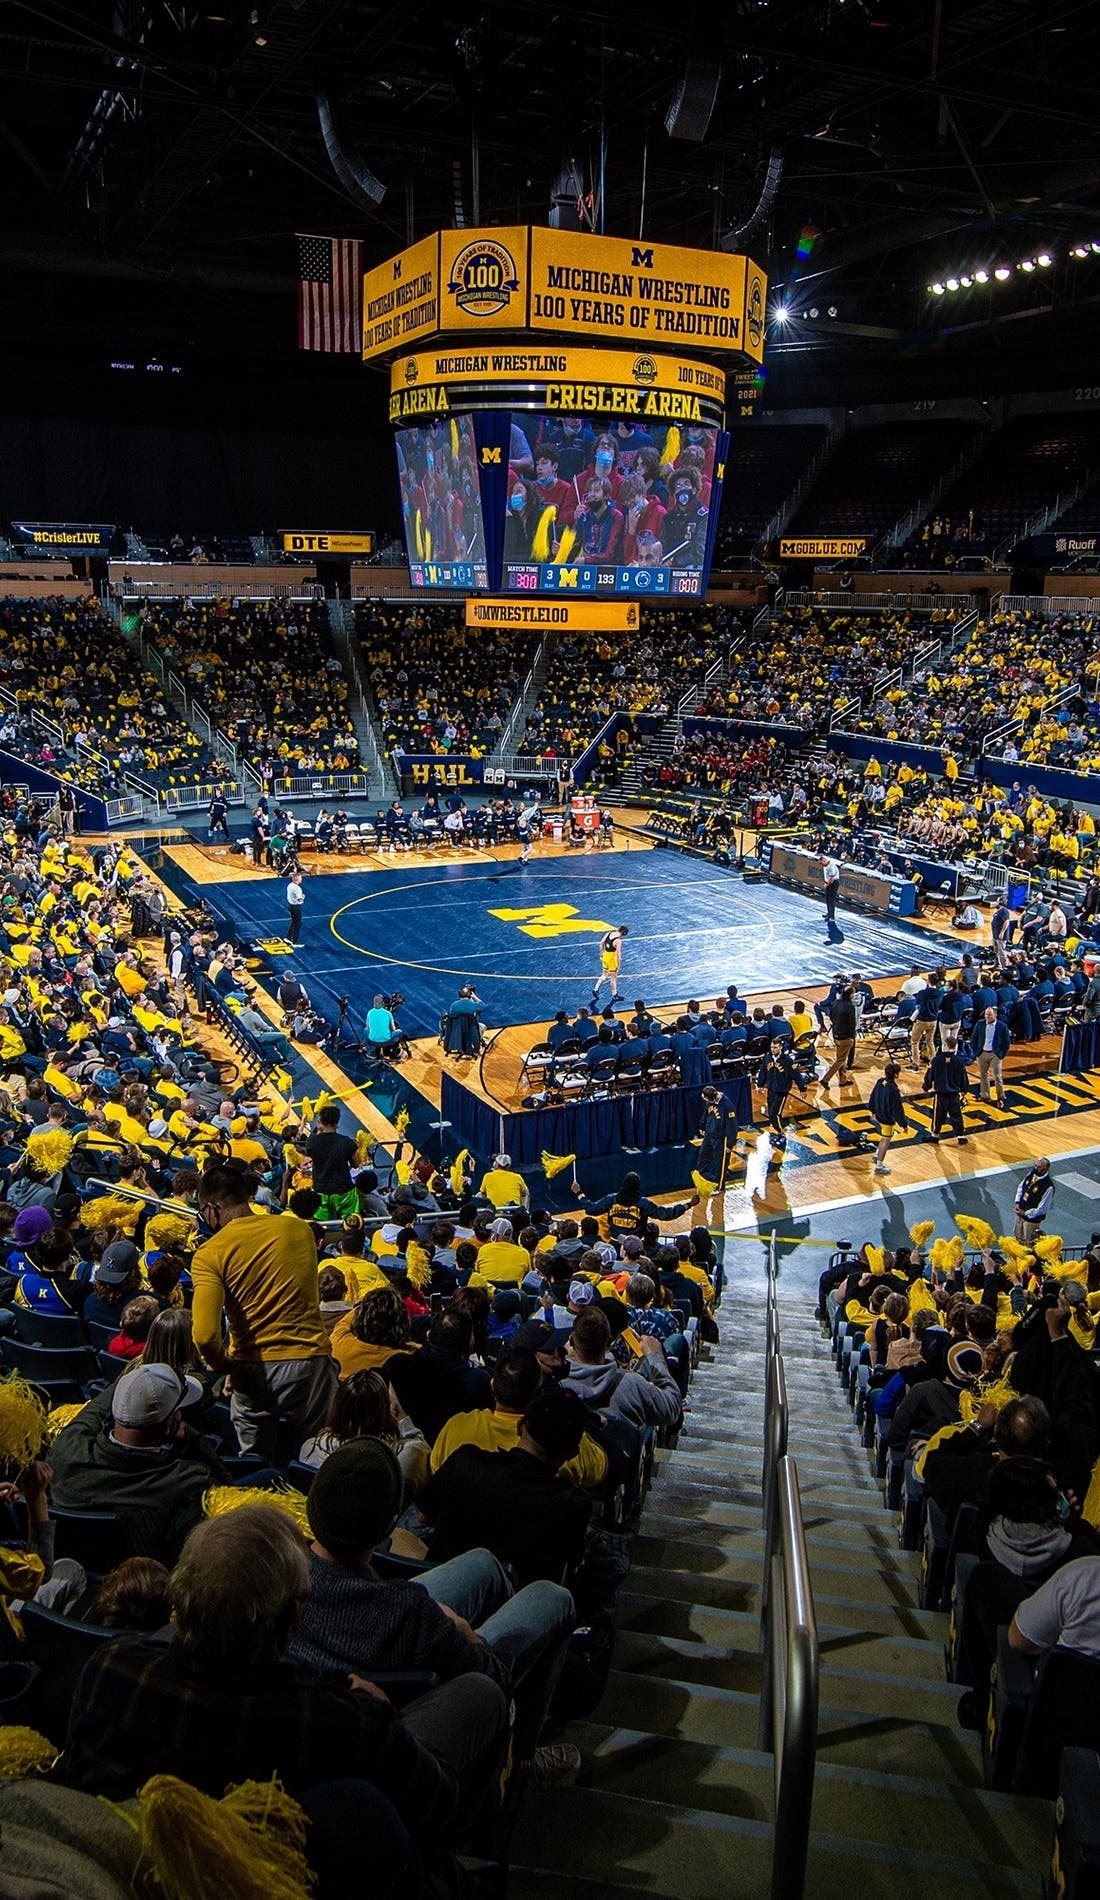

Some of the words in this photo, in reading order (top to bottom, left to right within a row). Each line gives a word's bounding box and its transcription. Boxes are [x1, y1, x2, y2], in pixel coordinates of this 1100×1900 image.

[488, 246, 511, 277] TRADITION
[631, 247, 654, 268] M
[393, 260, 402, 280] M
[467, 265, 499, 288] 100
[547, 265, 634, 298] MICHIGAN
[638, 276, 730, 309] WRESTLING
[367, 290, 395, 322] MICHIGAN
[396, 272, 432, 308] WRESTLING
[458, 291, 482, 303] MICHIGAN
[482, 291, 509, 301] WRESTLING
[363, 328, 374, 350] 100
[374, 319, 392, 346] YEARS
[393, 315, 400, 336] OF
[402, 298, 437, 333] TRADITION
[534, 294, 565, 319] 100
[570, 298, 625, 326] YEARS
[629, 305, 650, 329] OF
[654, 308, 740, 339] TRADITION
[435, 355, 489, 374] MICHIGAN
[491, 355, 567, 371] WRESTLING
[678, 366, 693, 383] 100
[695, 369, 714, 388] YEARS
[403, 386, 449, 415] ARENA
[545, 383, 640, 414] CRISLER
[644, 391, 702, 420] ARENA
[738, 390, 757, 399] 2021
[741, 405, 753, 416] M
[914, 400, 936, 411] 219
[482, 447, 501, 463] M
[717, 462, 725, 478] M
[33, 531, 101, 544] #CrislerLIVE
[292, 536, 329, 550] DTE
[1068, 539, 1097, 550] Ruoff
[782, 542, 864, 554] MGOBLUE.COM
[547, 570, 554, 580] 3
[559, 568, 578, 588] M
[584, 571, 591, 581] 0
[597, 574, 615, 585] 133
[622, 572, 629, 582] 0
[657, 573, 664, 583] 3
[678, 579, 698, 593] 0:00
[474, 605, 568, 623] #UMWRESTLE100
[411, 764, 473, 784] HAIL
[583, 814, 593, 826] G
[18, 1262, 25, 1270] K
[38, 1288, 48, 1298] K
